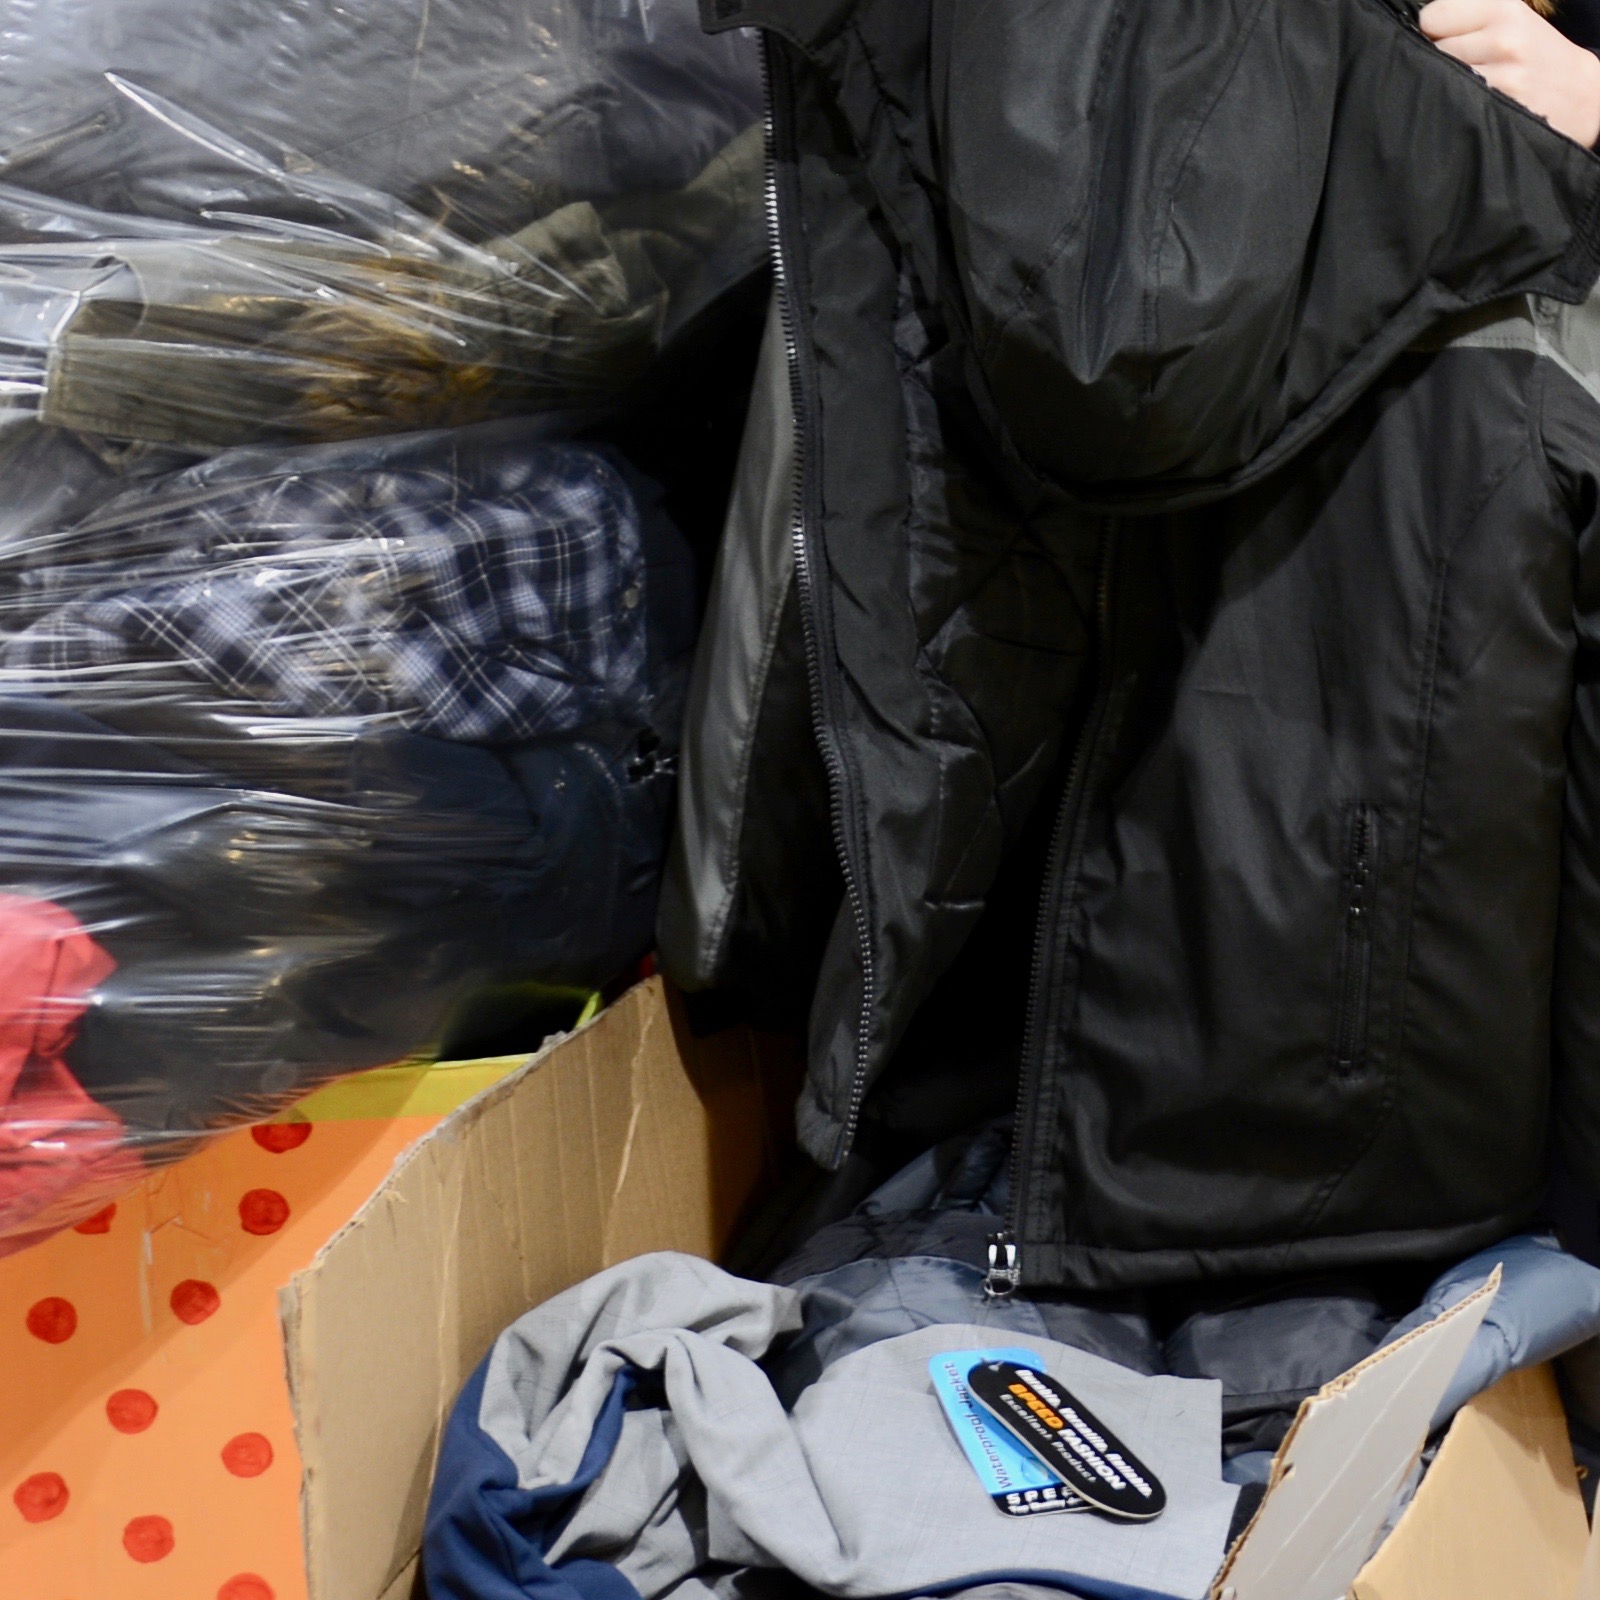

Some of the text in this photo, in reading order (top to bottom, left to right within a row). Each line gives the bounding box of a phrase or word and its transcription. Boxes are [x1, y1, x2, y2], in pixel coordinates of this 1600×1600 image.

[943, 1361, 1015, 1489] Waterproof Jacket
[999, 1392, 1097, 1484] Excellent Product
[1007, 1383, 1127, 1491] SPEED FASHION
